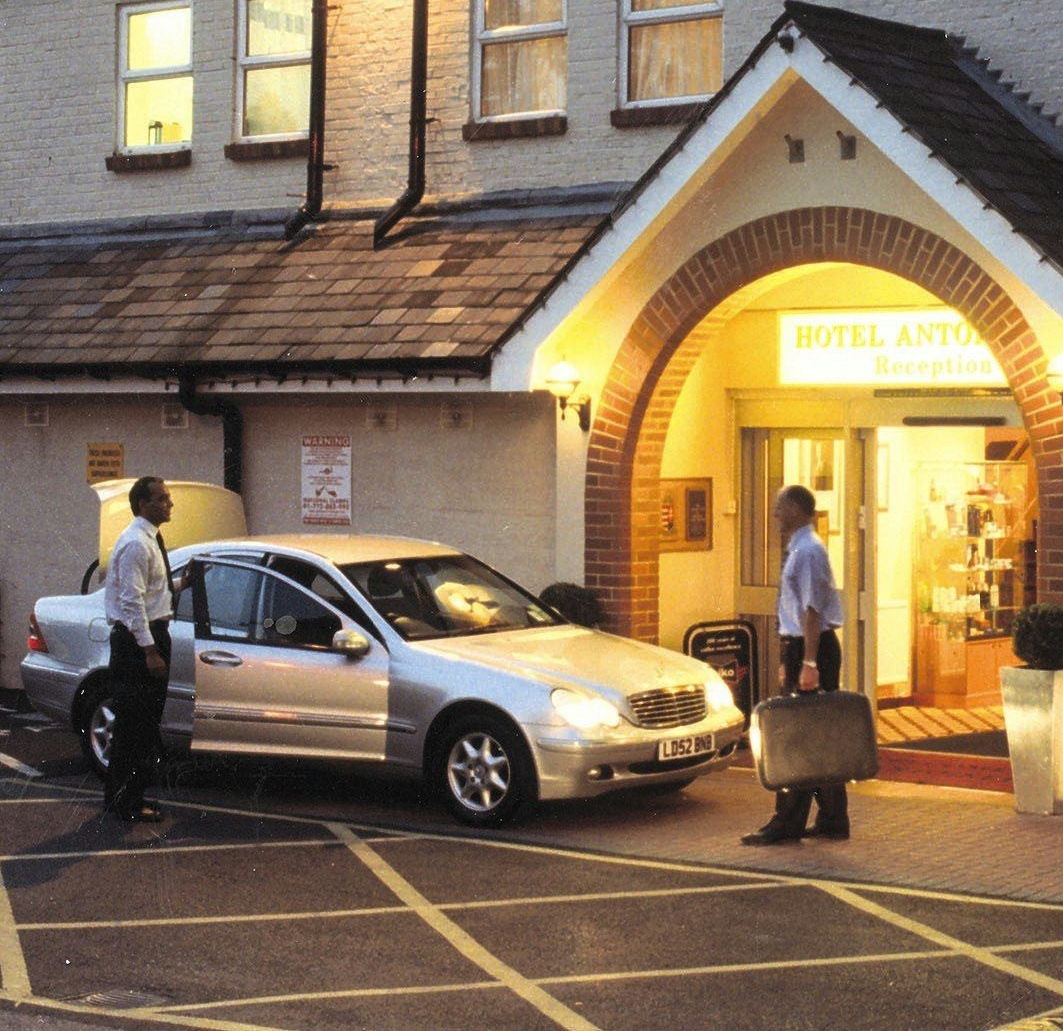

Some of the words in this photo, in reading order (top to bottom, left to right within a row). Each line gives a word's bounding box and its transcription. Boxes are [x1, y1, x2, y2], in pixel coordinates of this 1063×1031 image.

[795, 324, 885, 349] HOTEL
[895, 322, 984, 347] ANTO
[874, 355, 993, 378] Reception
[304, 437, 349, 446] WARNING
